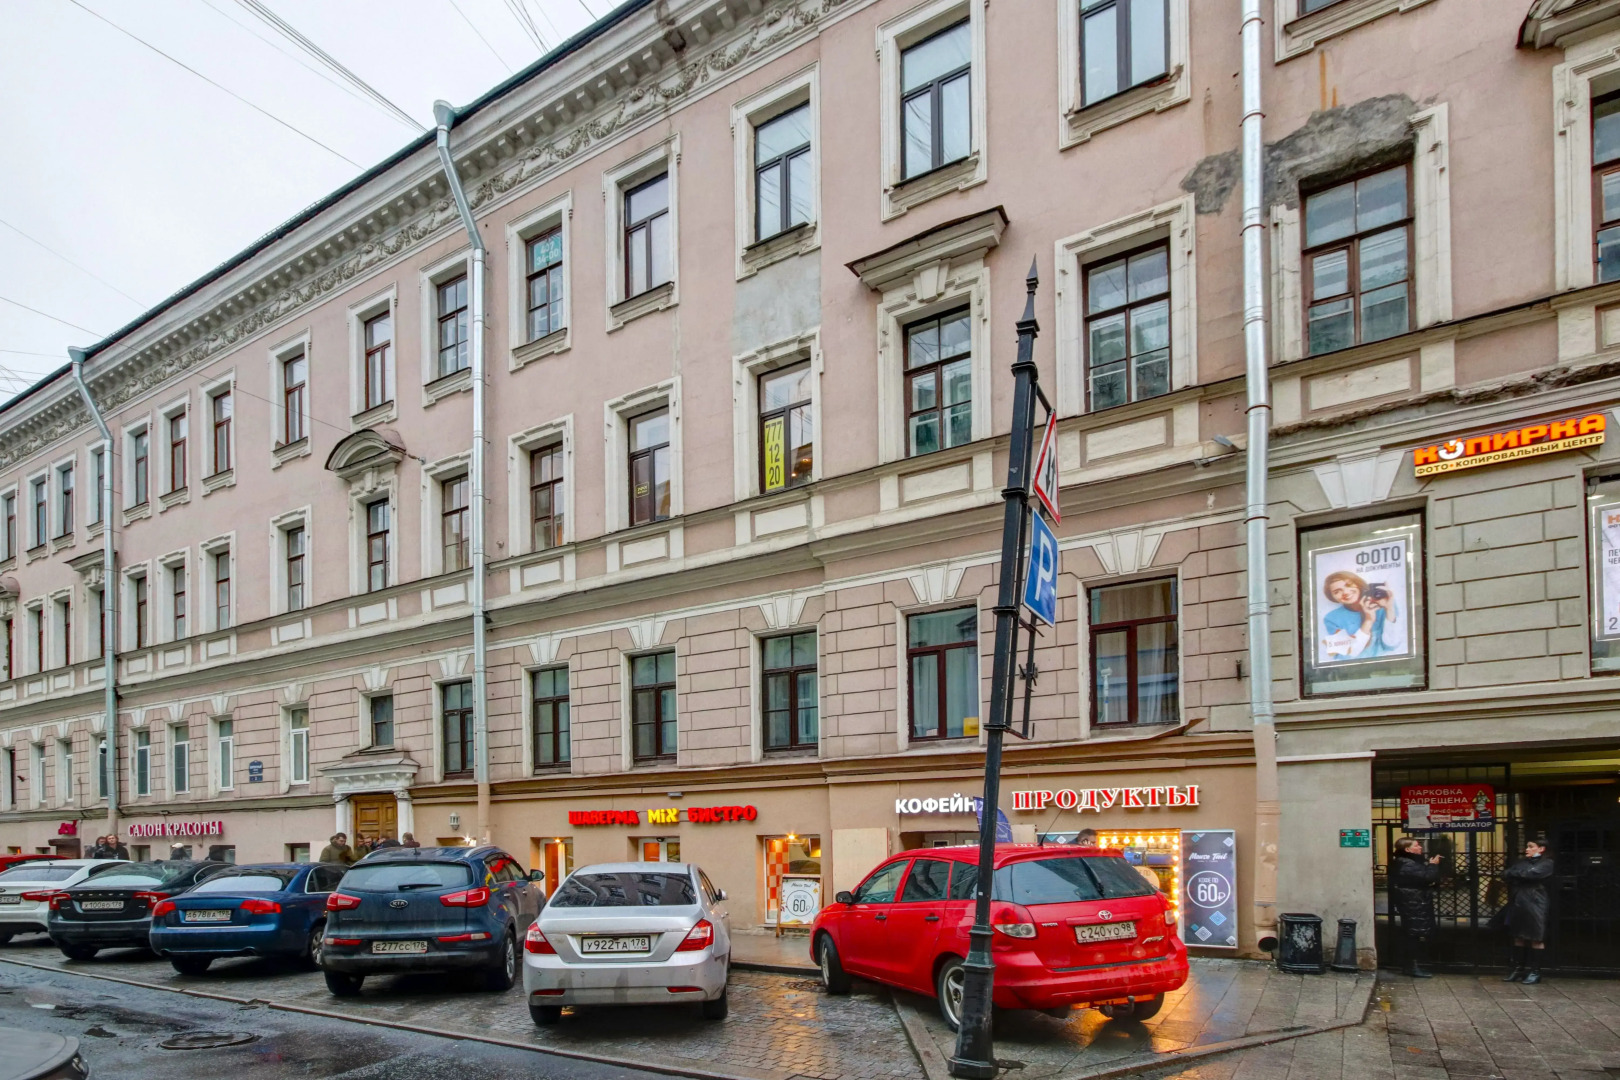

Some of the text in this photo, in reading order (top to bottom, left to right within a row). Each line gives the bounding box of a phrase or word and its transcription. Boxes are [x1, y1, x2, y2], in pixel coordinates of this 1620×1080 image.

[766, 421, 782, 443] 777
[1414, 413, 1606, 466] КОПИРКА
[769, 443, 780, 464] 12
[1416, 435, 1602, 475] ФОТО КОПИРОВАЛЬНЫЙ ЦЕНТР
[769, 465, 780, 486] 20
[1356, 545, 1401, 566] ФОТО
[1365, 562, 1401, 572] ДОКУМЕНТЫ
[1012, 785, 1199, 812] ПРОДУКТЫ
[1404, 797, 1468, 805] ЗАПРЕЩЕНА
[1408, 788, 1463, 796] ПАРКОВКА
[568, 810, 640, 825] ШАВЕРМА
[687, 805, 758, 823] БИСТРО
[1446, 821, 1492, 829] ЭВАКУАТОР
[128, 821, 221, 837] САЛОН КРАСОТЫ
